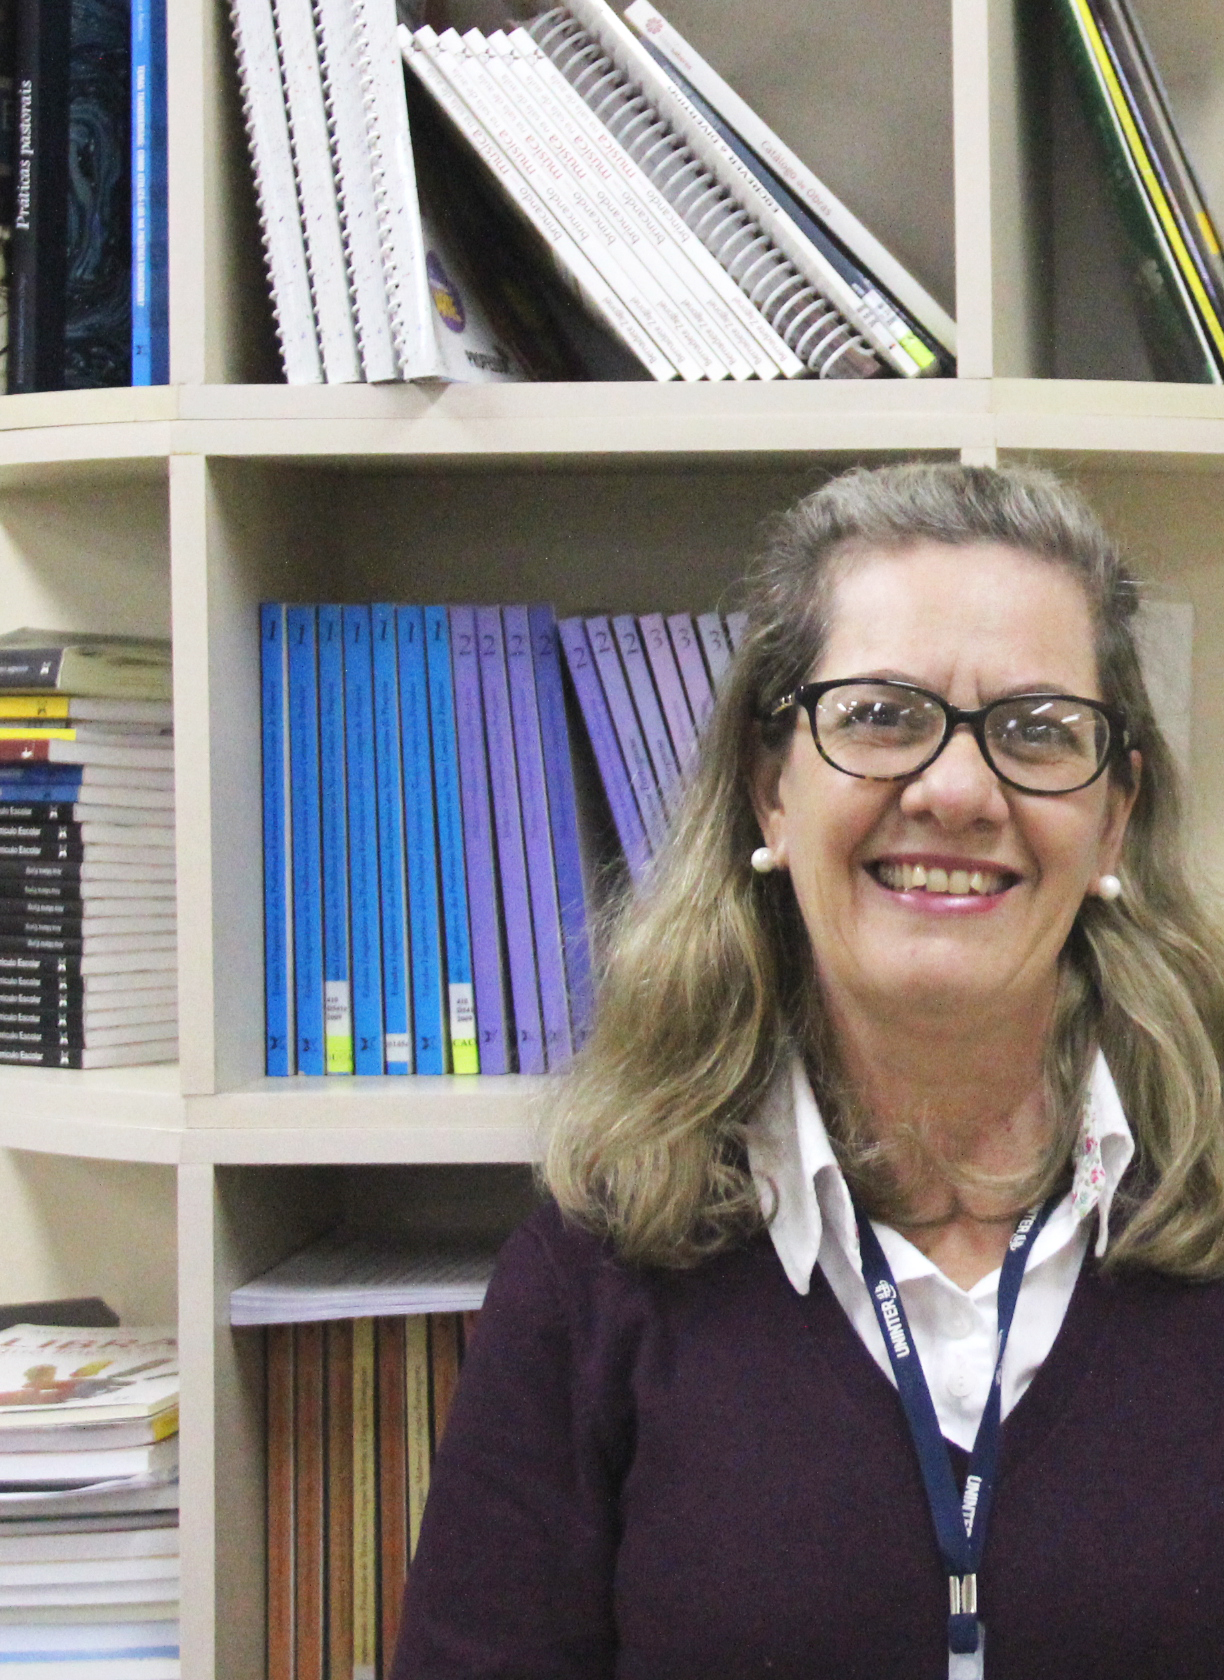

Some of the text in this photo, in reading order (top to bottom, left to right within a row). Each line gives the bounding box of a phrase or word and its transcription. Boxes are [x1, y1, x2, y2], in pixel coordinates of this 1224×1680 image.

[16, 79, 33, 230] Práticas pastorais
[468, 128, 510, 177] música
[494, 128, 536, 177] música
[521, 133, 563, 182] música
[544, 133, 587, 182] música
[570, 133, 612, 182] música
[593, 133, 636, 181] música
[757, 139, 800, 181] Catálogo
[516, 186, 562, 241] brincando
[542, 186, 589, 241] brincando
[569, 190, 616, 245] brincando
[593, 190, 640, 245] brincando
[618, 190, 665, 245] brincando
[642, 189, 690, 243] brincando
[460, 634, 472, 656] 2
[484, 634, 496, 656] 2
[510, 634, 524, 656] 2
[540, 634, 553, 656] 2
[574, 646, 587, 669] 2
[596, 631, 610, 653] 2
[624, 632, 639, 654] 2
[650, 628, 663, 650] 3
[678, 628, 691, 650] 3
[710, 630, 722, 652] 3
[881, 1299, 910, 1358] UNINTER
